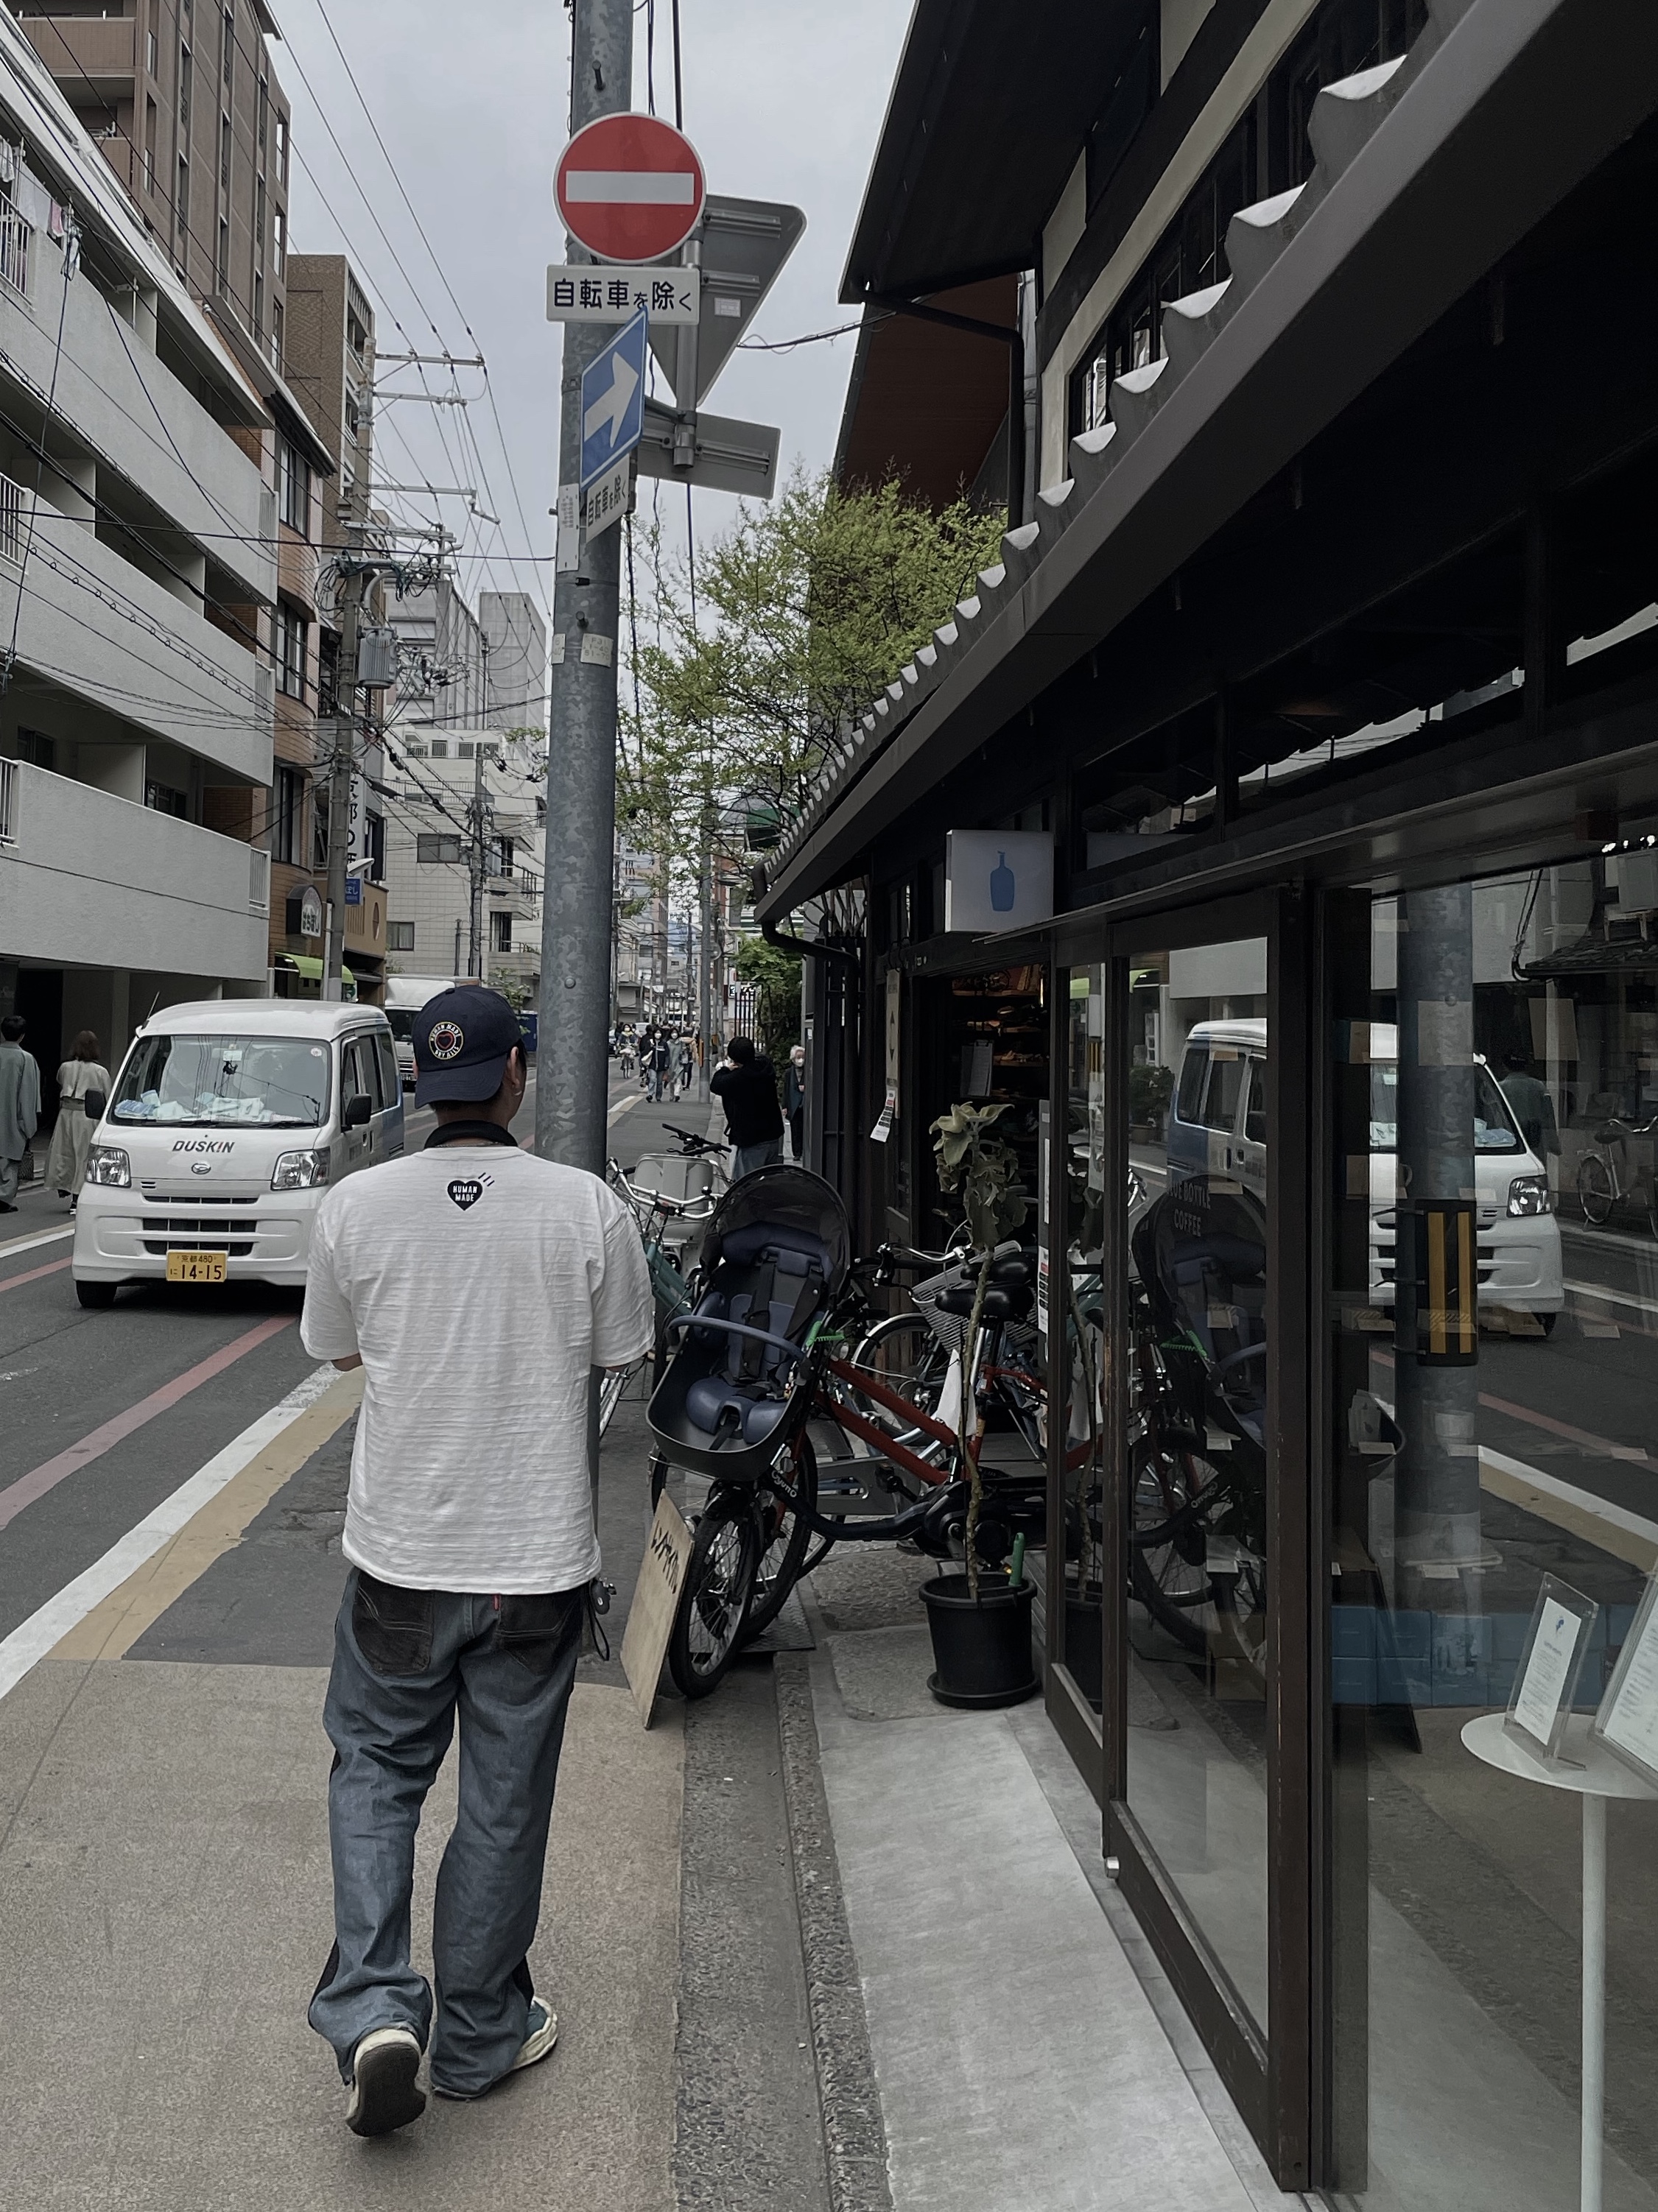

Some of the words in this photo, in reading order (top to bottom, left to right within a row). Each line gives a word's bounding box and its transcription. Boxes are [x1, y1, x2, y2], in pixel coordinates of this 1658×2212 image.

[554, 278, 692, 311] 自転車を除く
[446, 1024, 461, 1037] MADE
[452, 1186, 478, 1194] HUMAN
[454, 1194, 475, 1202] MADE
[181, 1264, 222, 1280] 14-15
